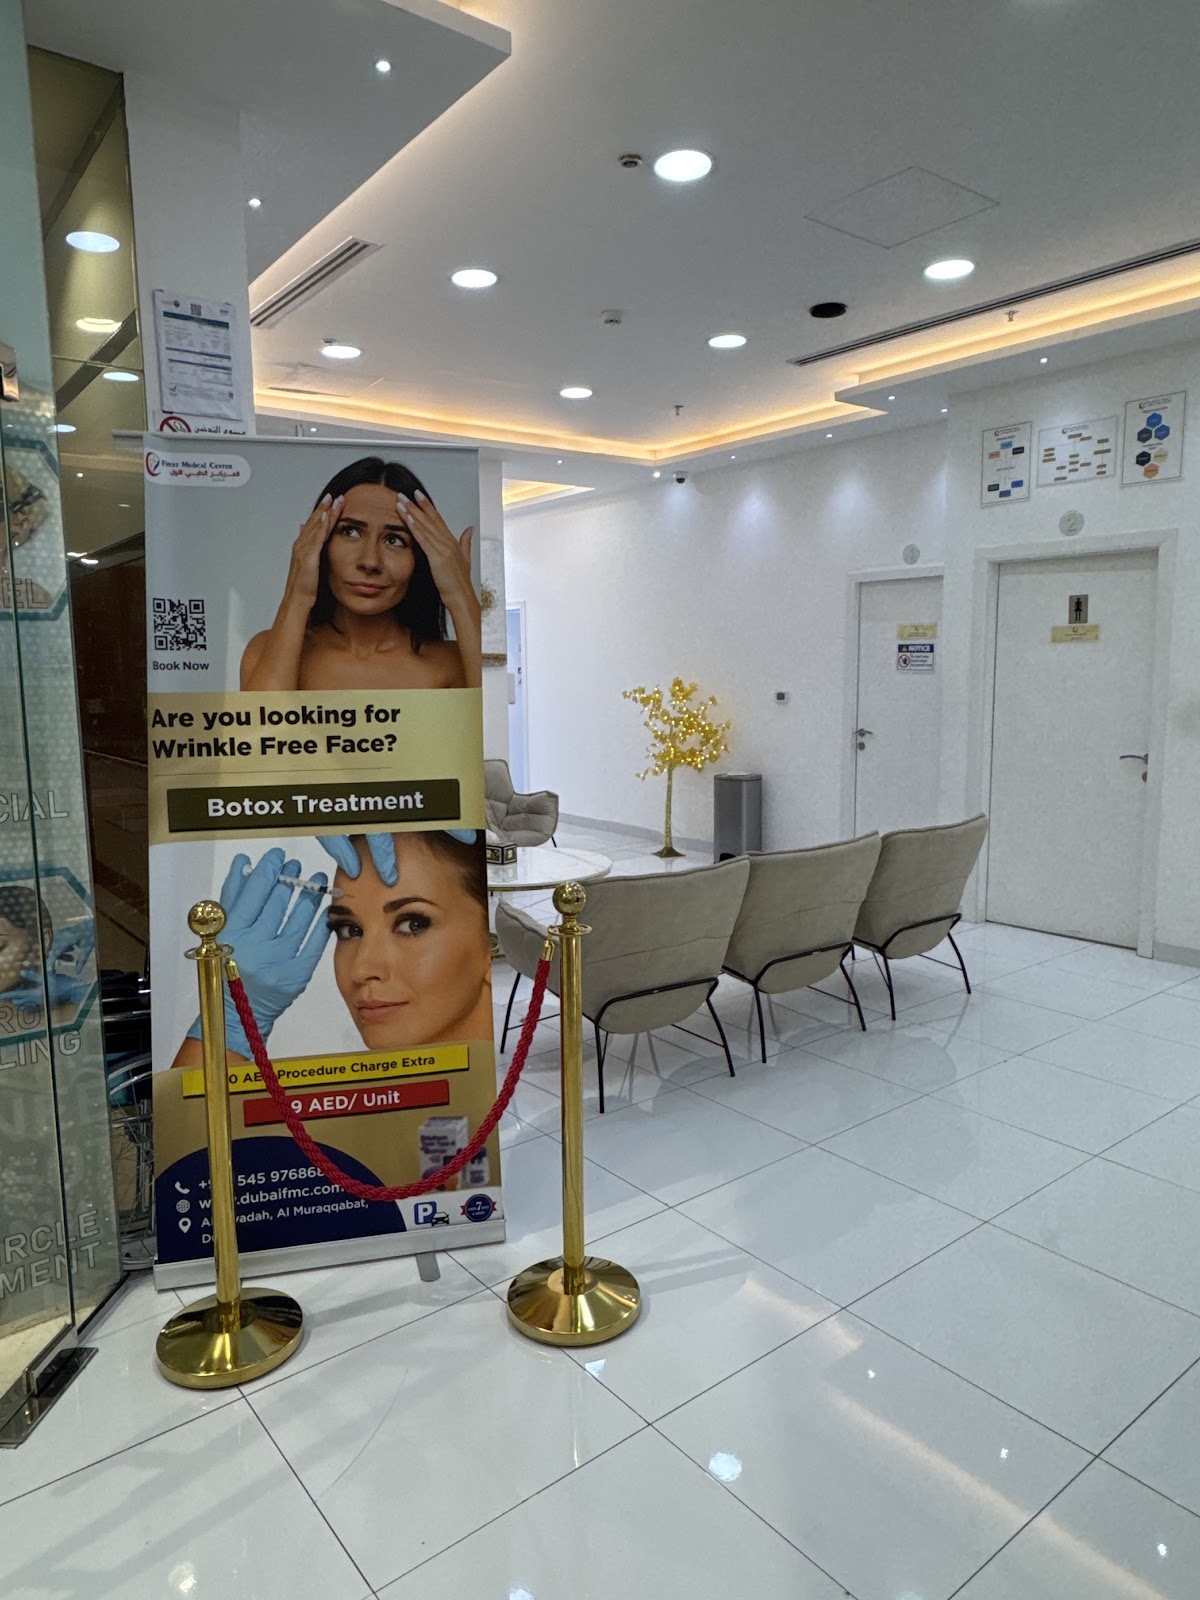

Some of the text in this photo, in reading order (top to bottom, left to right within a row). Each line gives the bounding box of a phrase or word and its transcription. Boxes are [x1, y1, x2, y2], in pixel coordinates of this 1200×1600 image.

[152, 660, 210, 672] Book Now
[151, 704, 401, 731] Are you looking for
[152, 733, 398, 759] Wrinkle Free Face?
[207, 790, 425, 818] Botox Treatment
[243, 1071, 263, 1083] AE
[277, 1065, 347, 1080] Procedure
[351, 1059, 398, 1075] Charge
[402, 1055, 436, 1069] Extra
[290, 1090, 400, 1114] 9 AED/ Unit
[237, 1172, 266, 1187] 545
[276, 1207, 290, 1219] Al
[293, 1199, 369, 1217] Muraqqabat,
